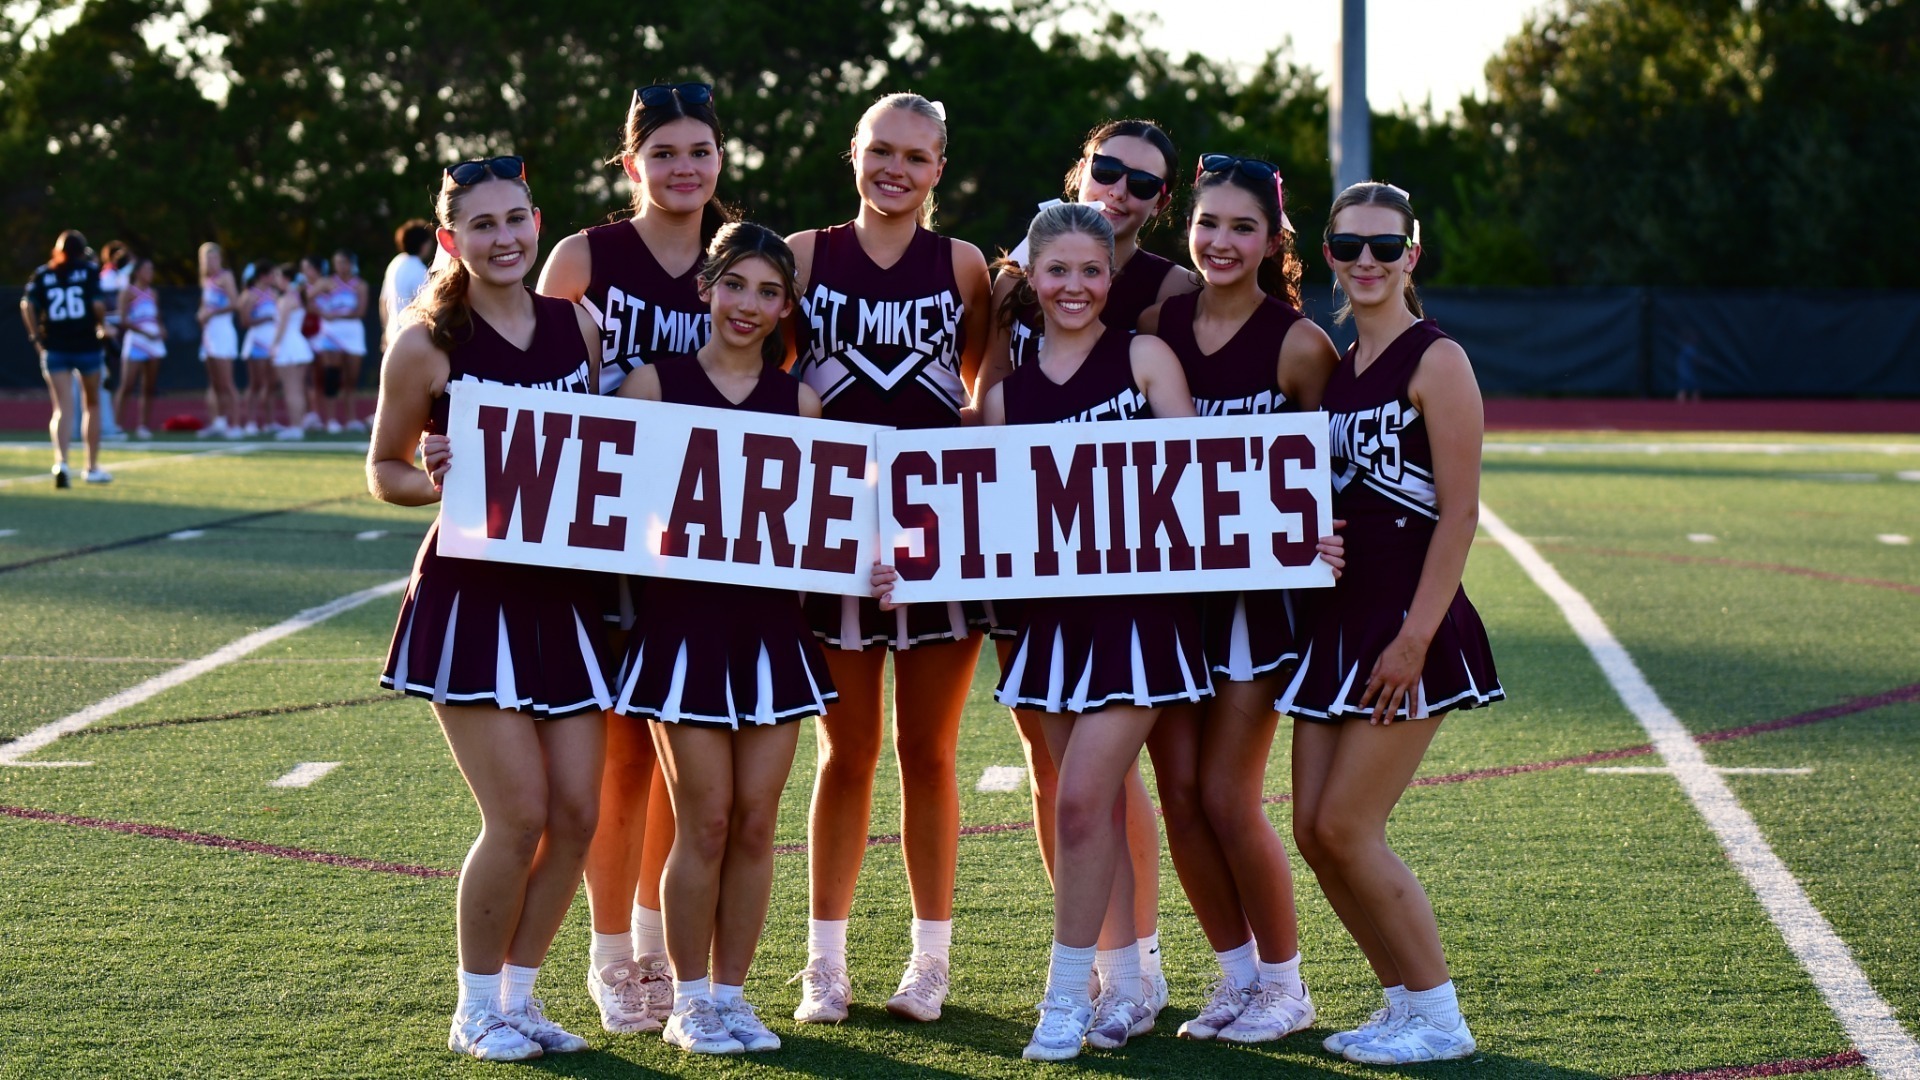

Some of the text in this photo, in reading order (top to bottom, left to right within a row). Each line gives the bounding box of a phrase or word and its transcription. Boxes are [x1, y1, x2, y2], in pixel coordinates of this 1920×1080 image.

[47, 286, 86, 321] 26
[602, 285, 646, 363] ST.
[810, 283, 957, 368] ST. MIKE'S
[477, 404, 868, 575] WE ARE
[891, 434, 1319, 581] ST. MIKE'S
